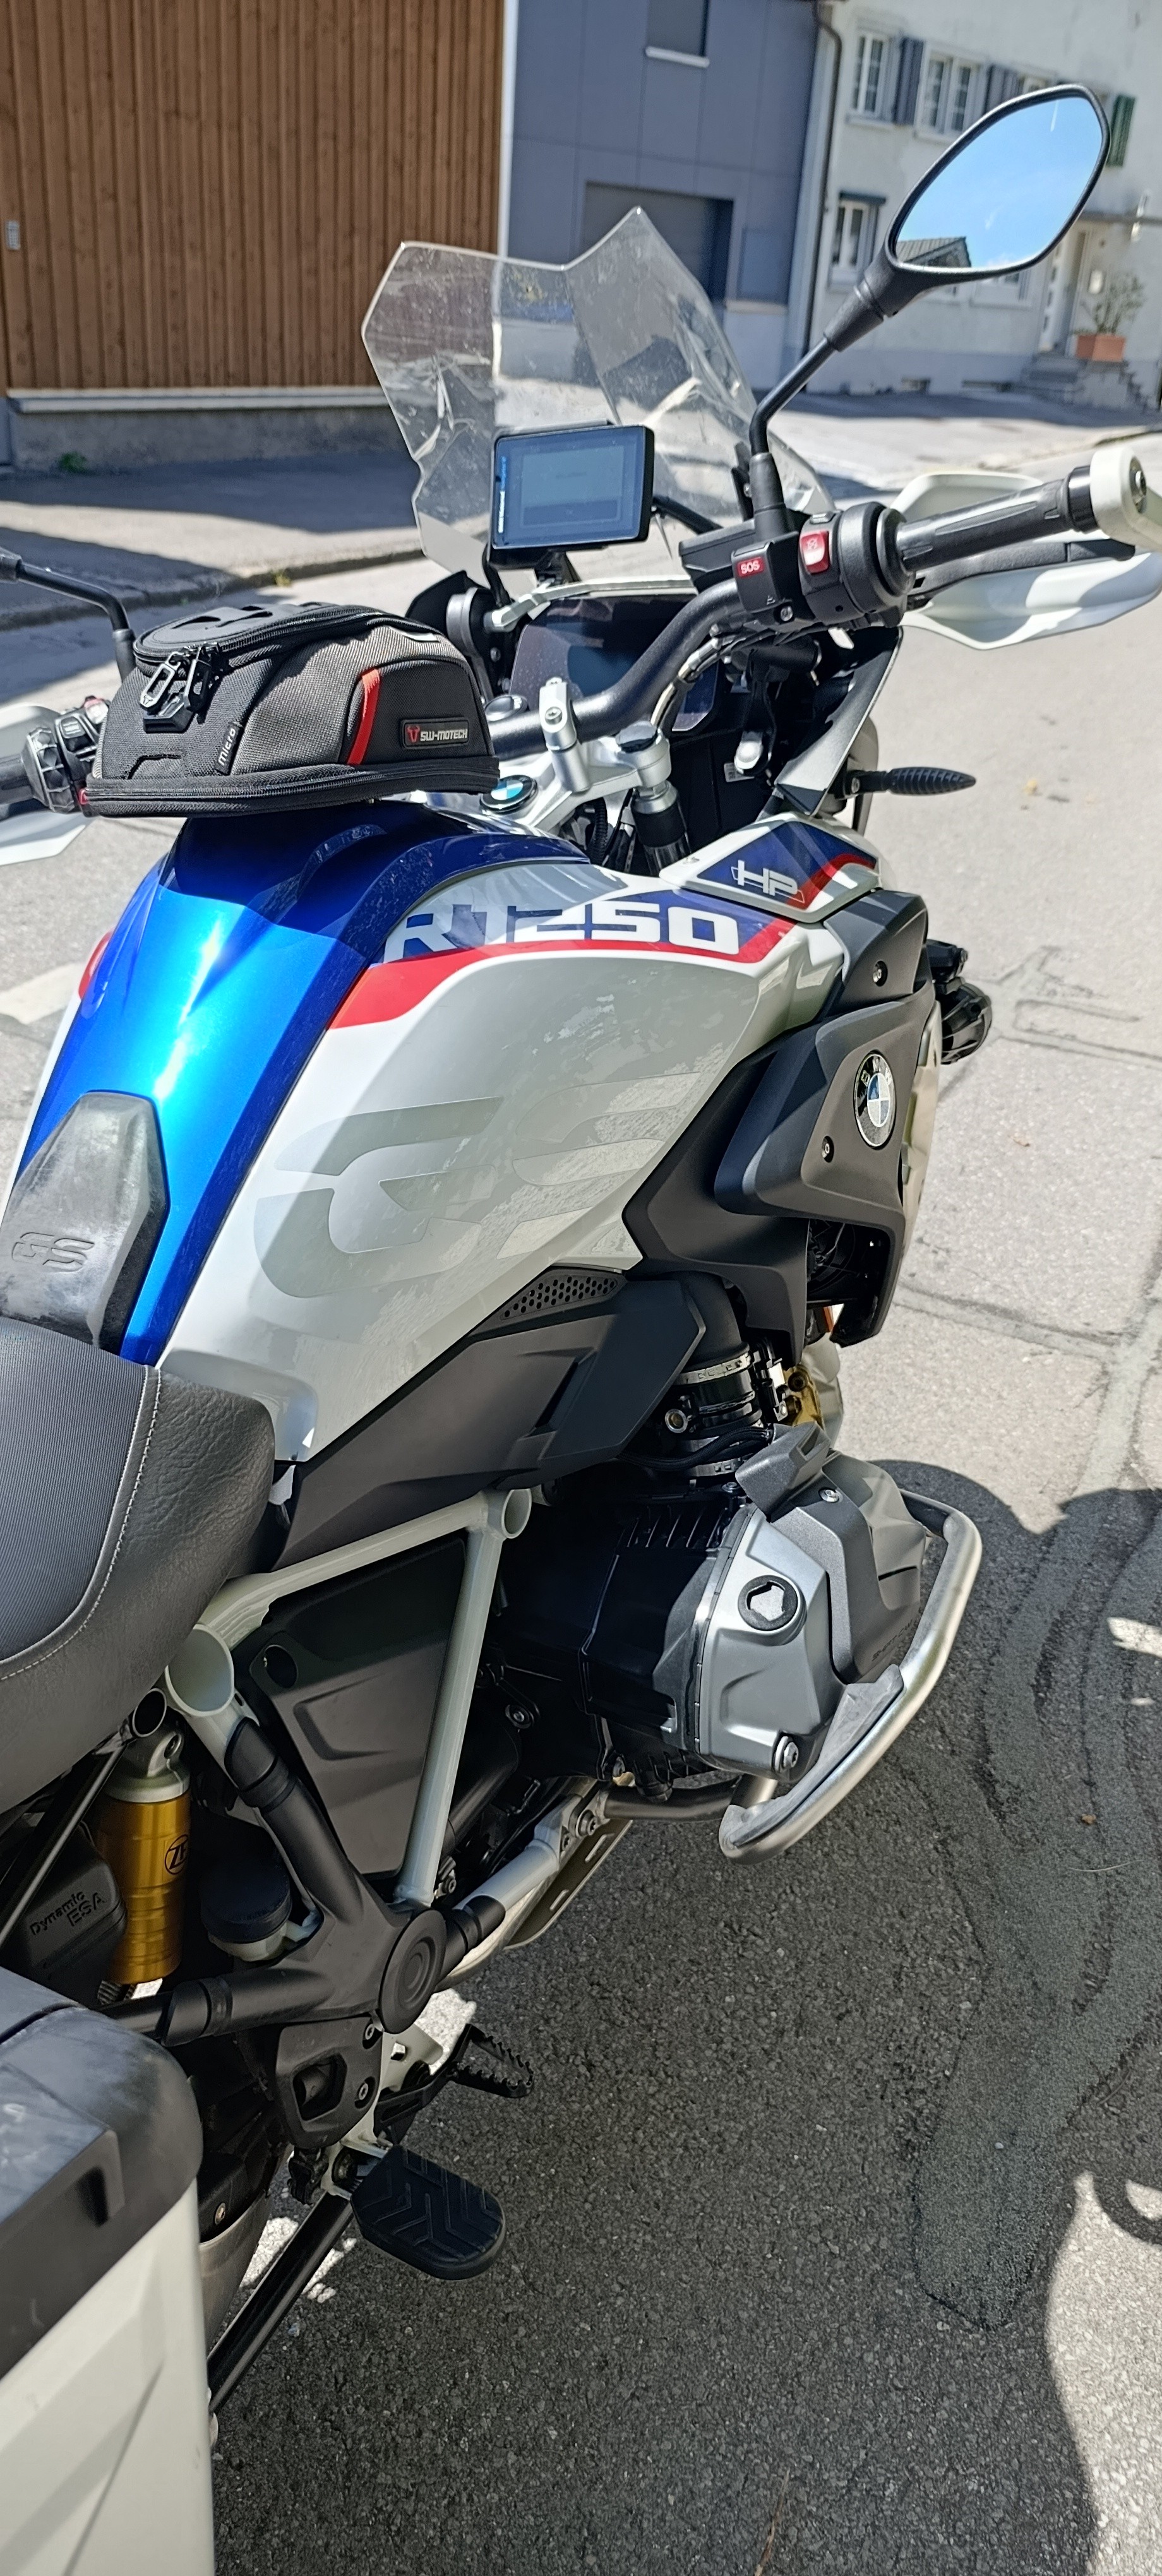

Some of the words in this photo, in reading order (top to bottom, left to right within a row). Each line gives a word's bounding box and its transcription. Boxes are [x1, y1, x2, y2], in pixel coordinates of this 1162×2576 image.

[740, 559, 760, 575] SOS
[420, 729, 468, 741] SW-MOTECH
[736, 859, 799, 897] HP
[11, 1232, 95, 1272] GS
[29, 1891, 85, 1936] Dynamic
[66, 1892, 106, 1926] ESA
